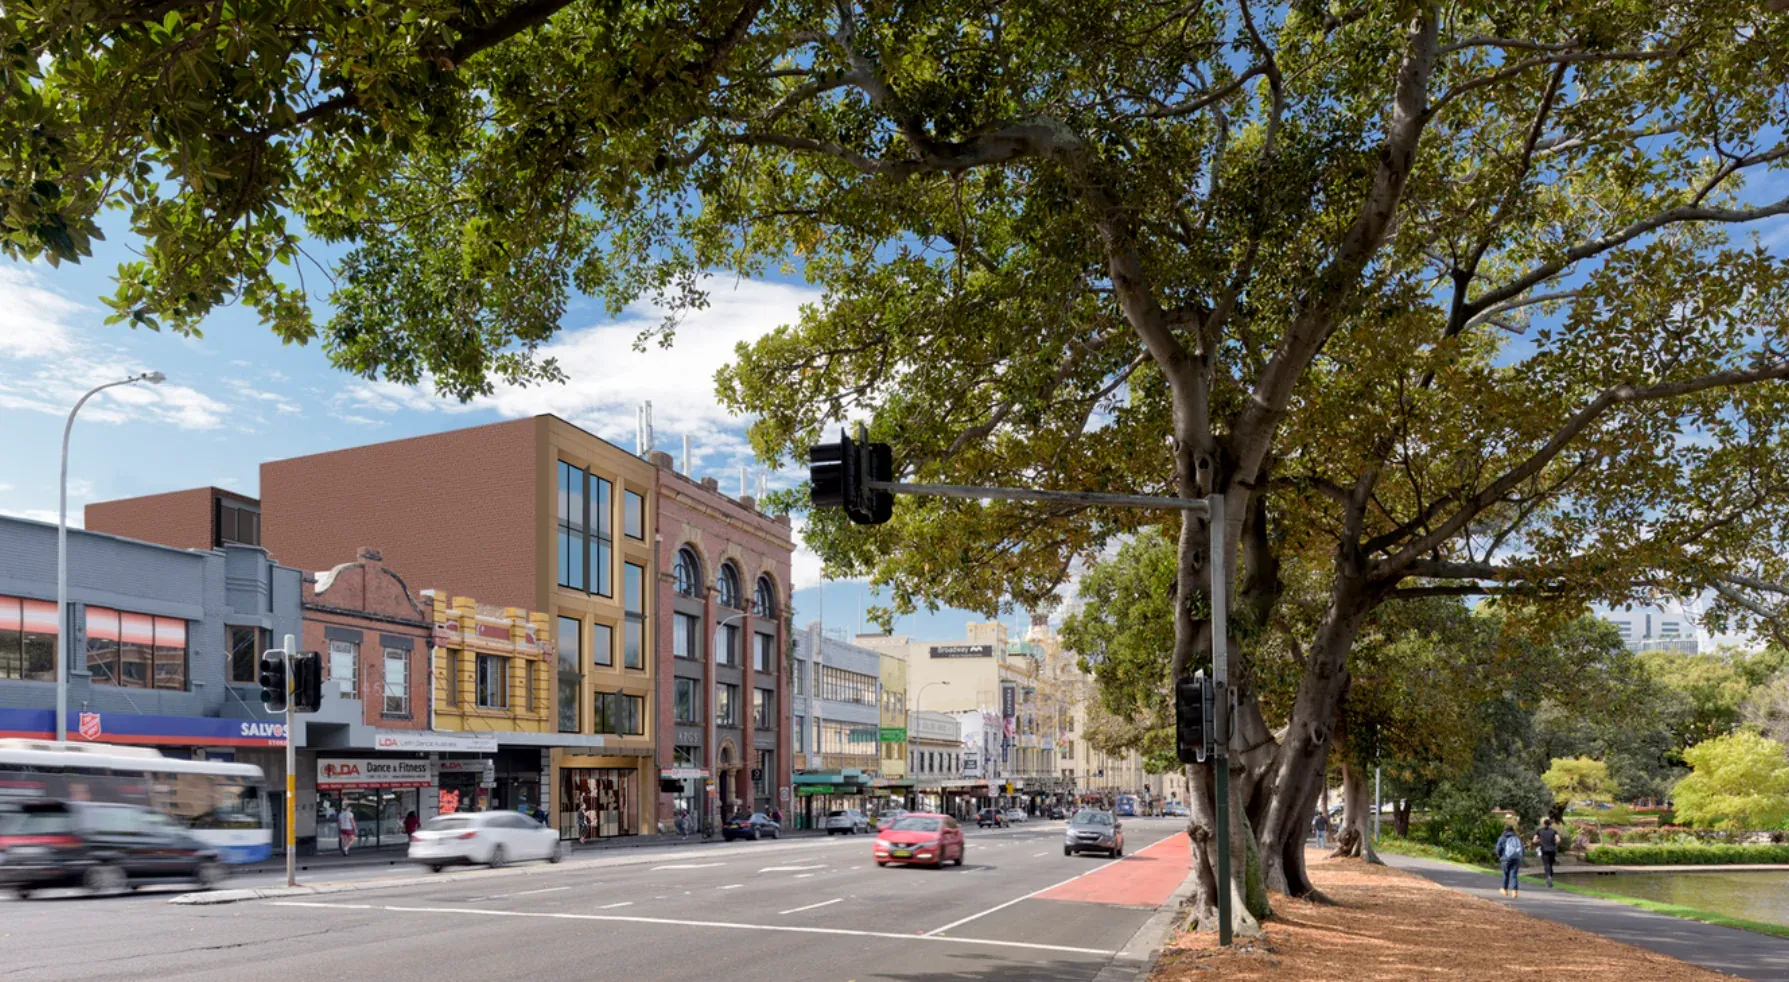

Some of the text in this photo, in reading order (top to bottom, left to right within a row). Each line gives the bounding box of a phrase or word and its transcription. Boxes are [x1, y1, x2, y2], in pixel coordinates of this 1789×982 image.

[937, 646, 969, 654] Broadway
[379, 738, 398, 747] LDA
[332, 764, 360, 776] LDA
[366, 761, 391, 773] Dance
[398, 761, 426, 773] Fitness
